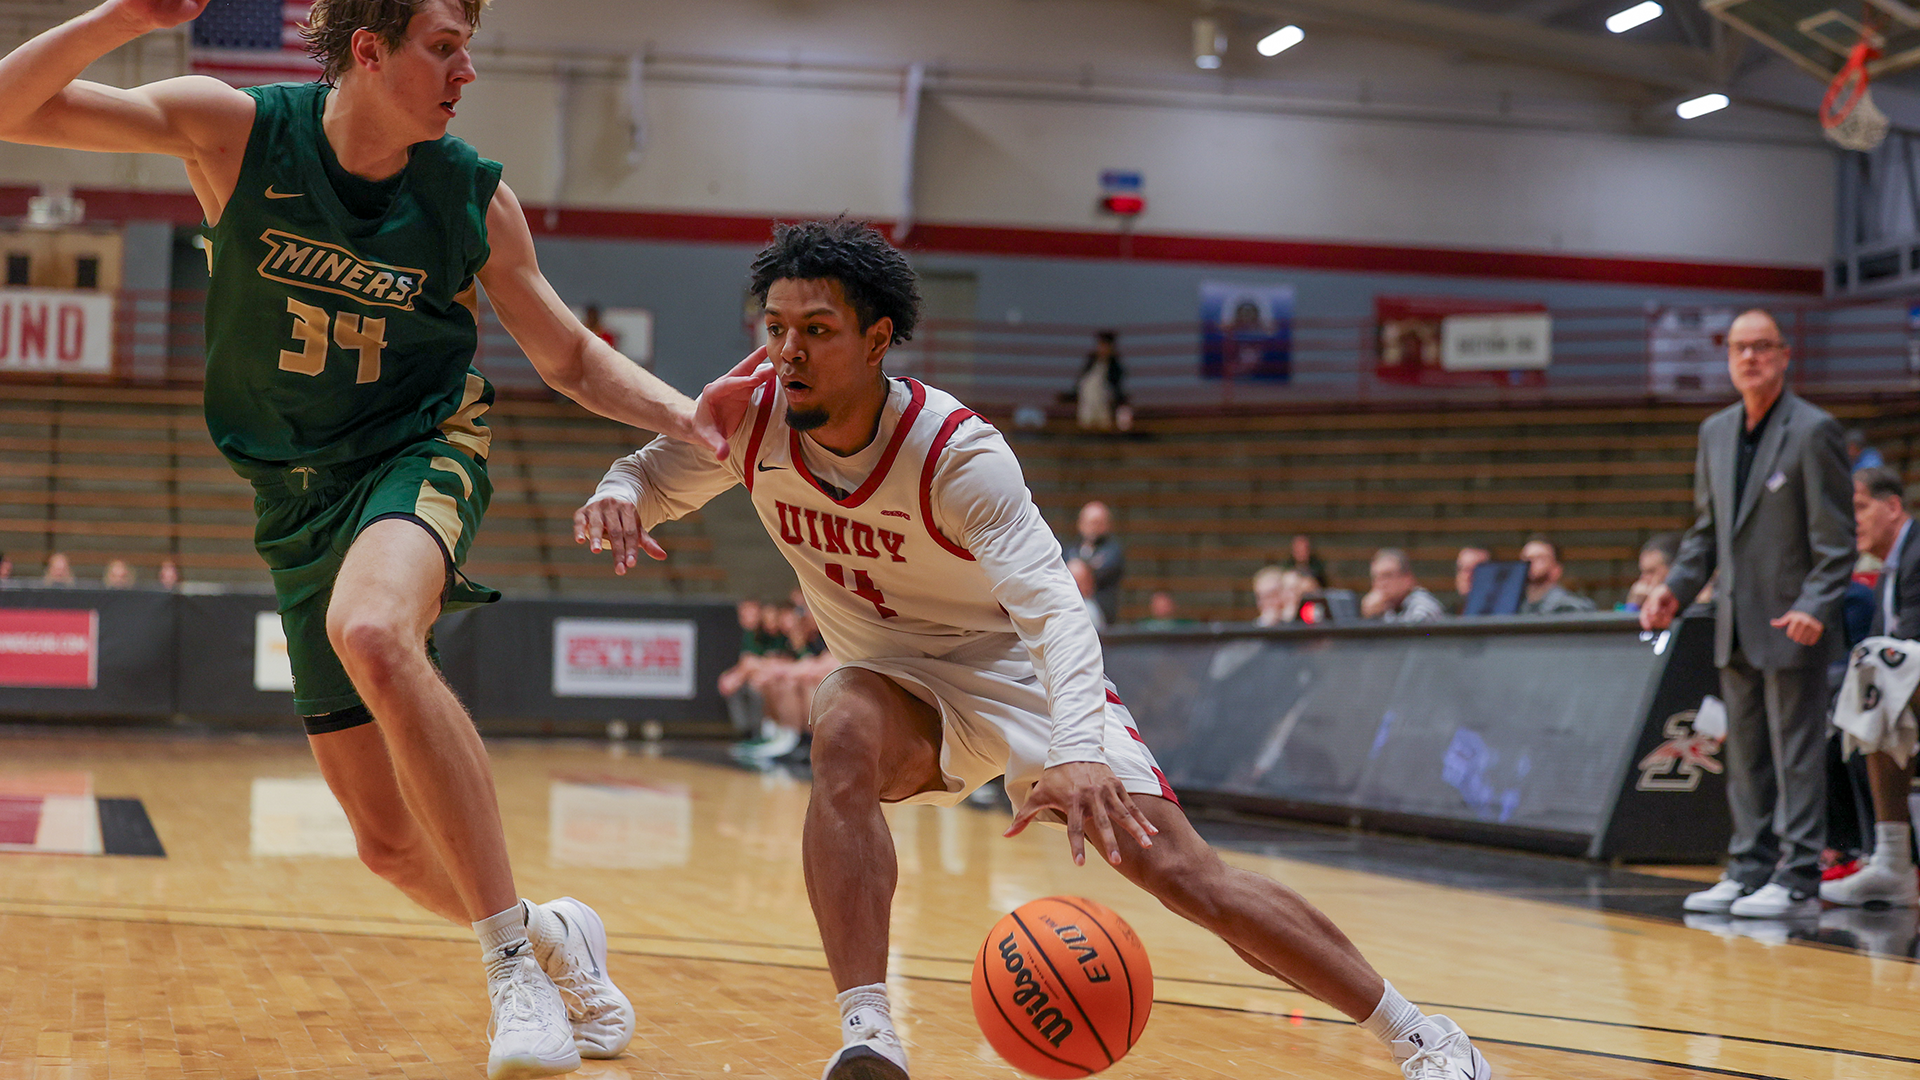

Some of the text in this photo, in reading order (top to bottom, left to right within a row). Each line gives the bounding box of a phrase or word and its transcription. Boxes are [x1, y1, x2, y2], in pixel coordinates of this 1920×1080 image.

[271, 240, 413, 301] MINERS
[278, 297, 388, 384] 34
[774, 499, 907, 563] UINDY
[1054, 924, 1111, 984] EVO
[998, 931, 1074, 1049] Wilson
